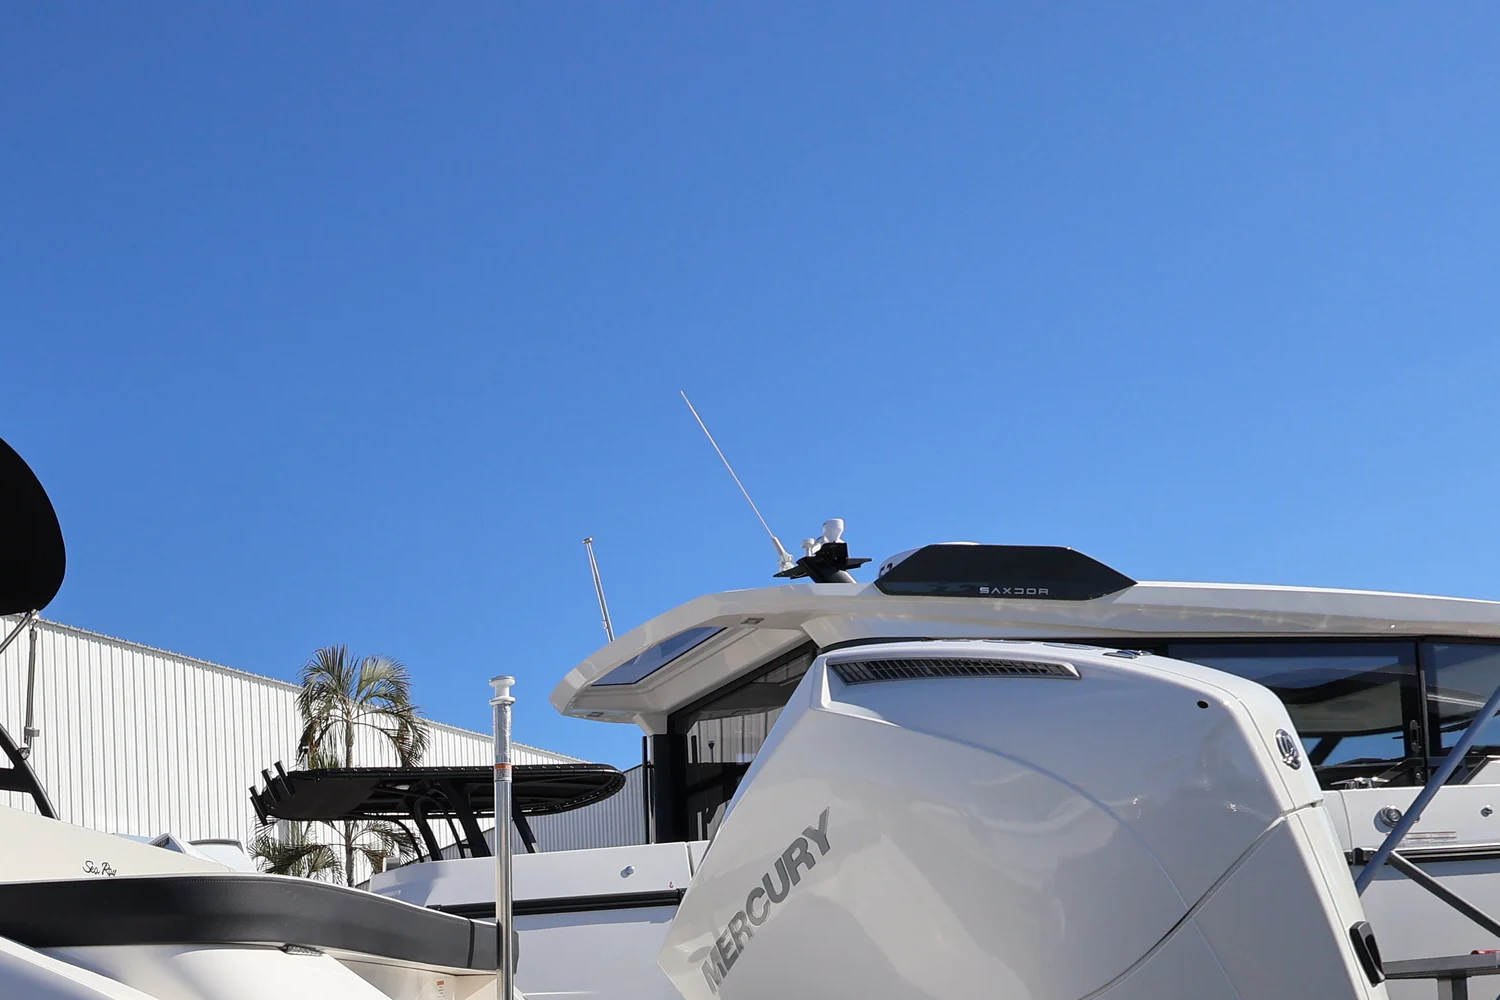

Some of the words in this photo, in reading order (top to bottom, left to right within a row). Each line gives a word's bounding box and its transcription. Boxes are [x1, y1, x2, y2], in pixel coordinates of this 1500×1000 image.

[979, 586, 1049, 596] SAXDOR
[82, 860, 100, 875] Sea
[701, 806, 831, 995] MERCURY
